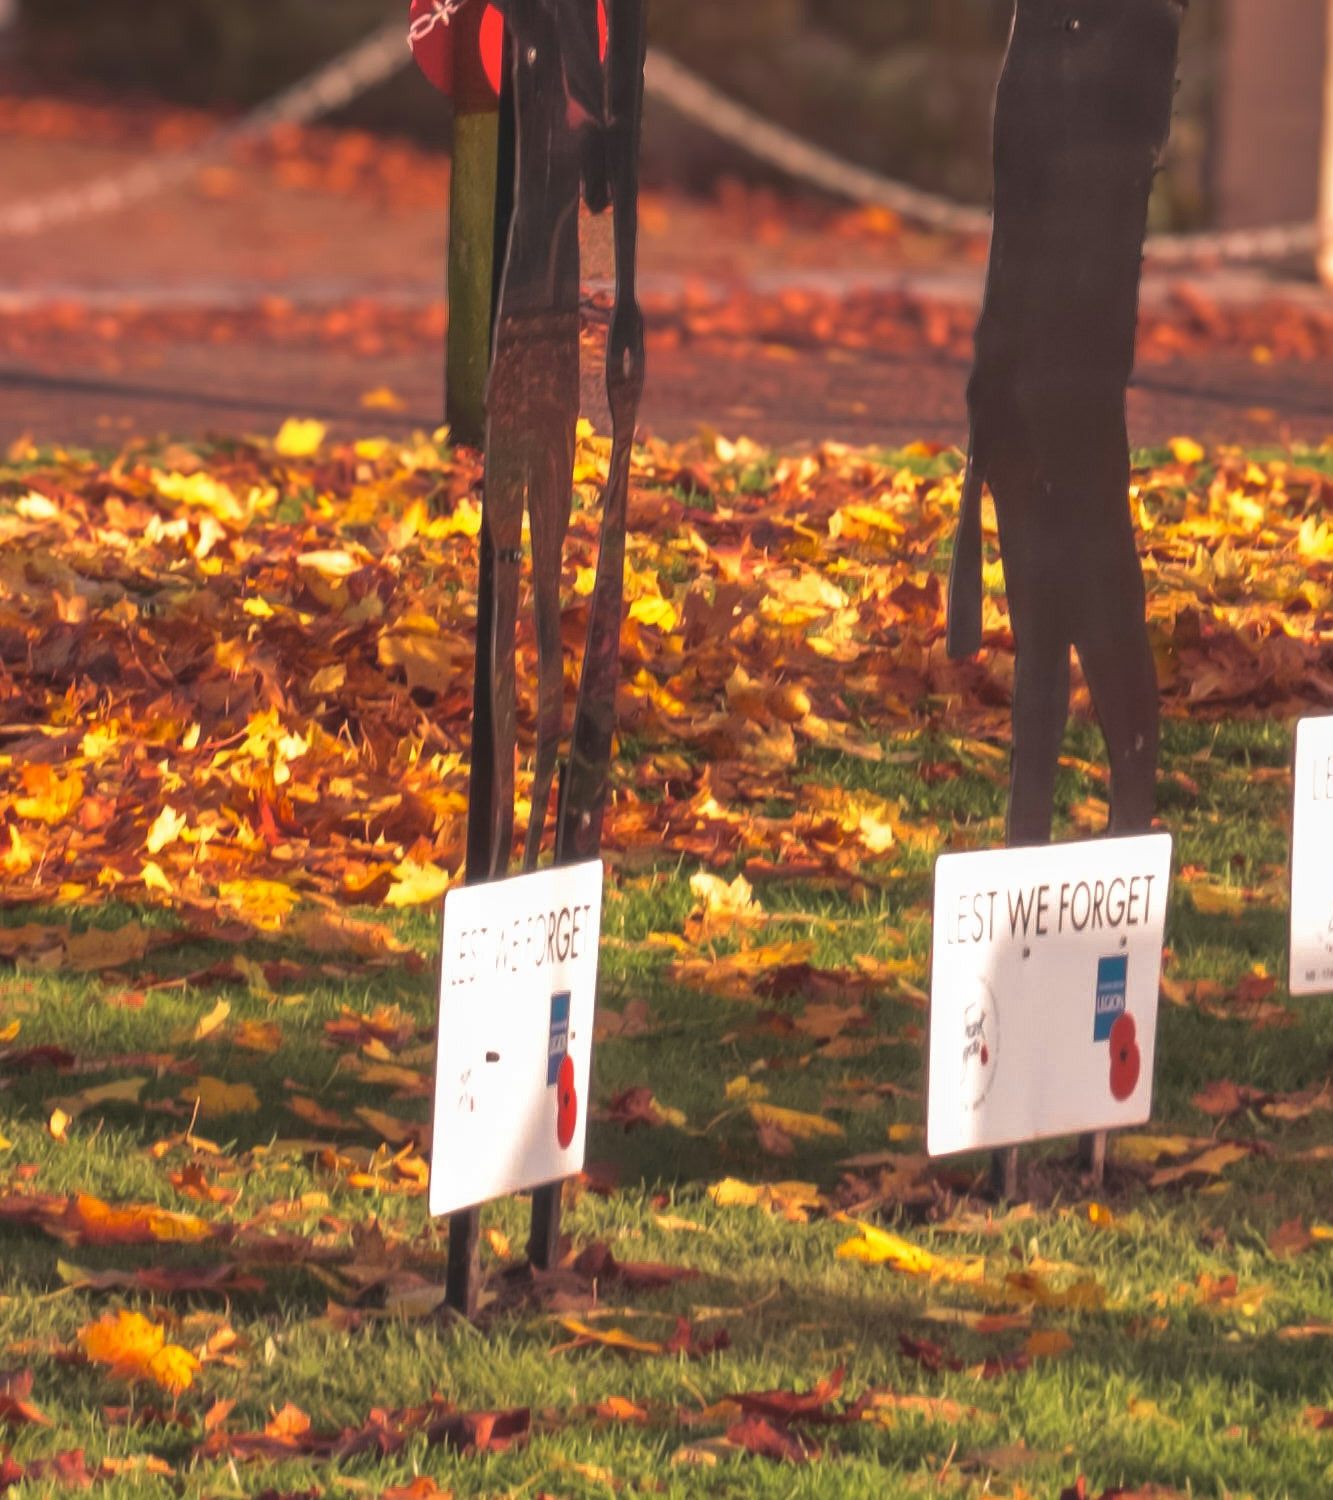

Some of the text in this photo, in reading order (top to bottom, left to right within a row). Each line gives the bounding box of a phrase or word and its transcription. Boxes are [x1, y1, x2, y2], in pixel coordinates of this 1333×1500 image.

[451, 926, 488, 986] EST
[526, 903, 592, 968] FORGET
[947, 874, 1156, 945] EST WE FORGET
